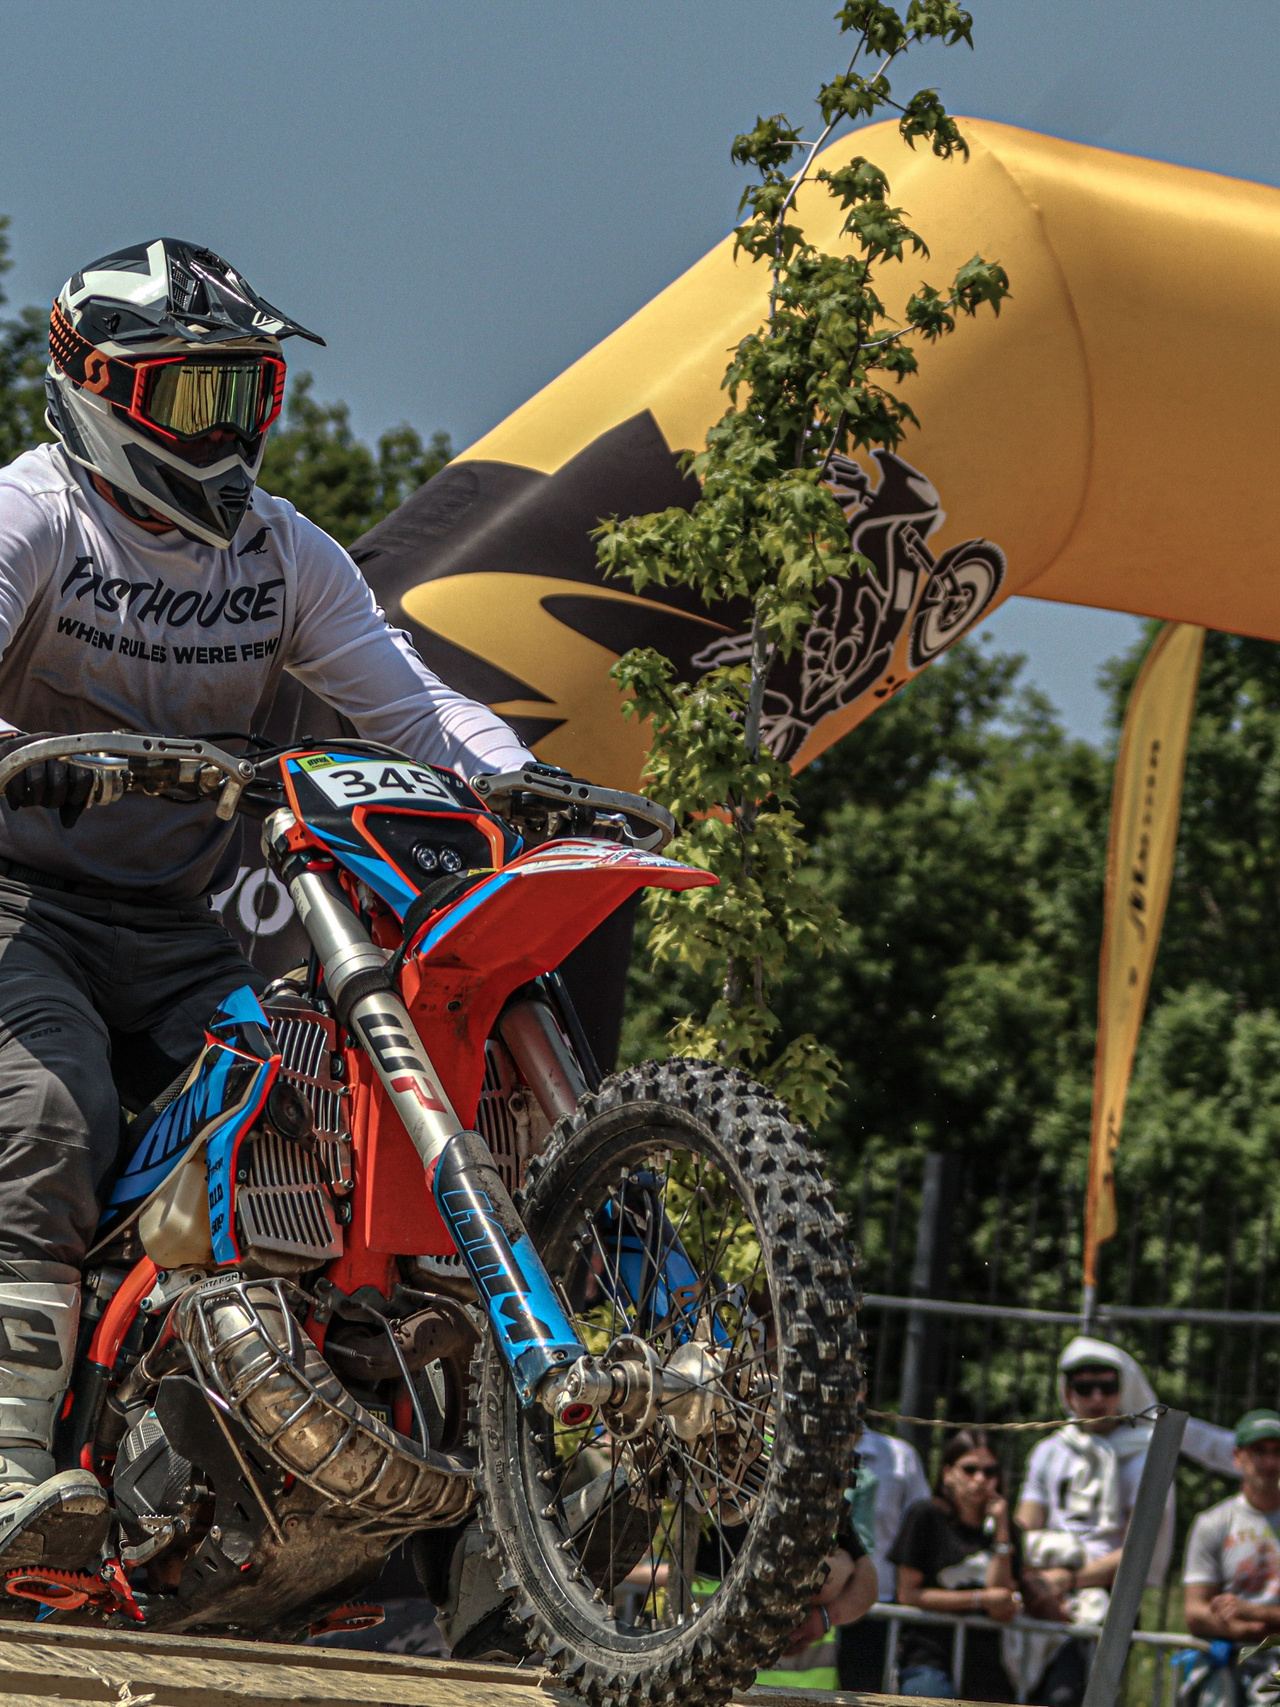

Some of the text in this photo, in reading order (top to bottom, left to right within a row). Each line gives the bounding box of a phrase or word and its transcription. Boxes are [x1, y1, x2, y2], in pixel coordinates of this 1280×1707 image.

[60, 555, 286, 629] FASTHOUSE
[57, 616, 280, 665] WHEN RULES WERE FEW
[328, 767, 450, 800] 345
[441, 1189, 556, 1346] KTM
